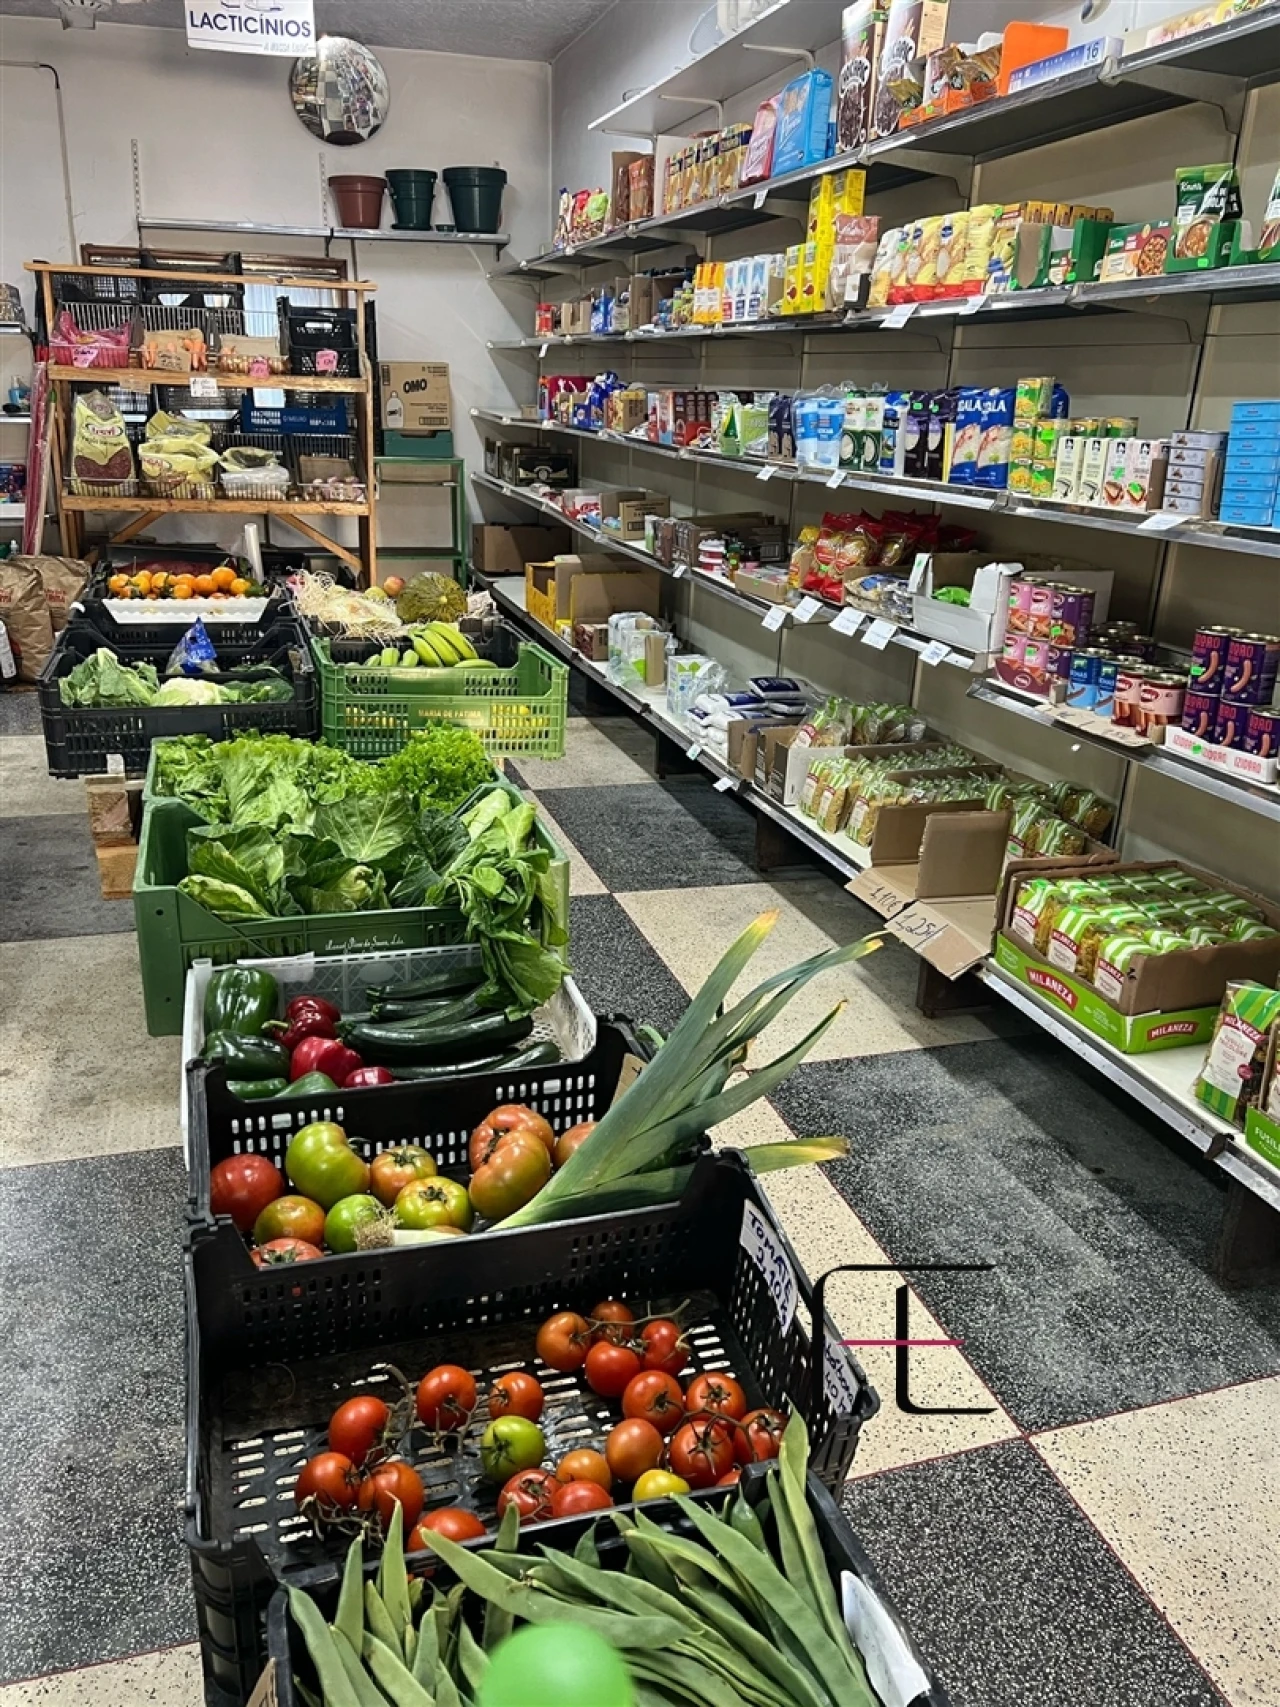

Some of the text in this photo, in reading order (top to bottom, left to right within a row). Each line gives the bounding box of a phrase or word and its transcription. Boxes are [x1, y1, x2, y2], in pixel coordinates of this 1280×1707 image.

[189, 10, 311, 38] LACTICÍNIOS
[1085, 42, 1098, 60] 16
[403, 378, 427, 394] OMO
[1028, 970, 1074, 1006] MILANEZA
[1150, 1022, 1194, 1038] MILANEZA
[748, 1210, 794, 1298] TOMATE
